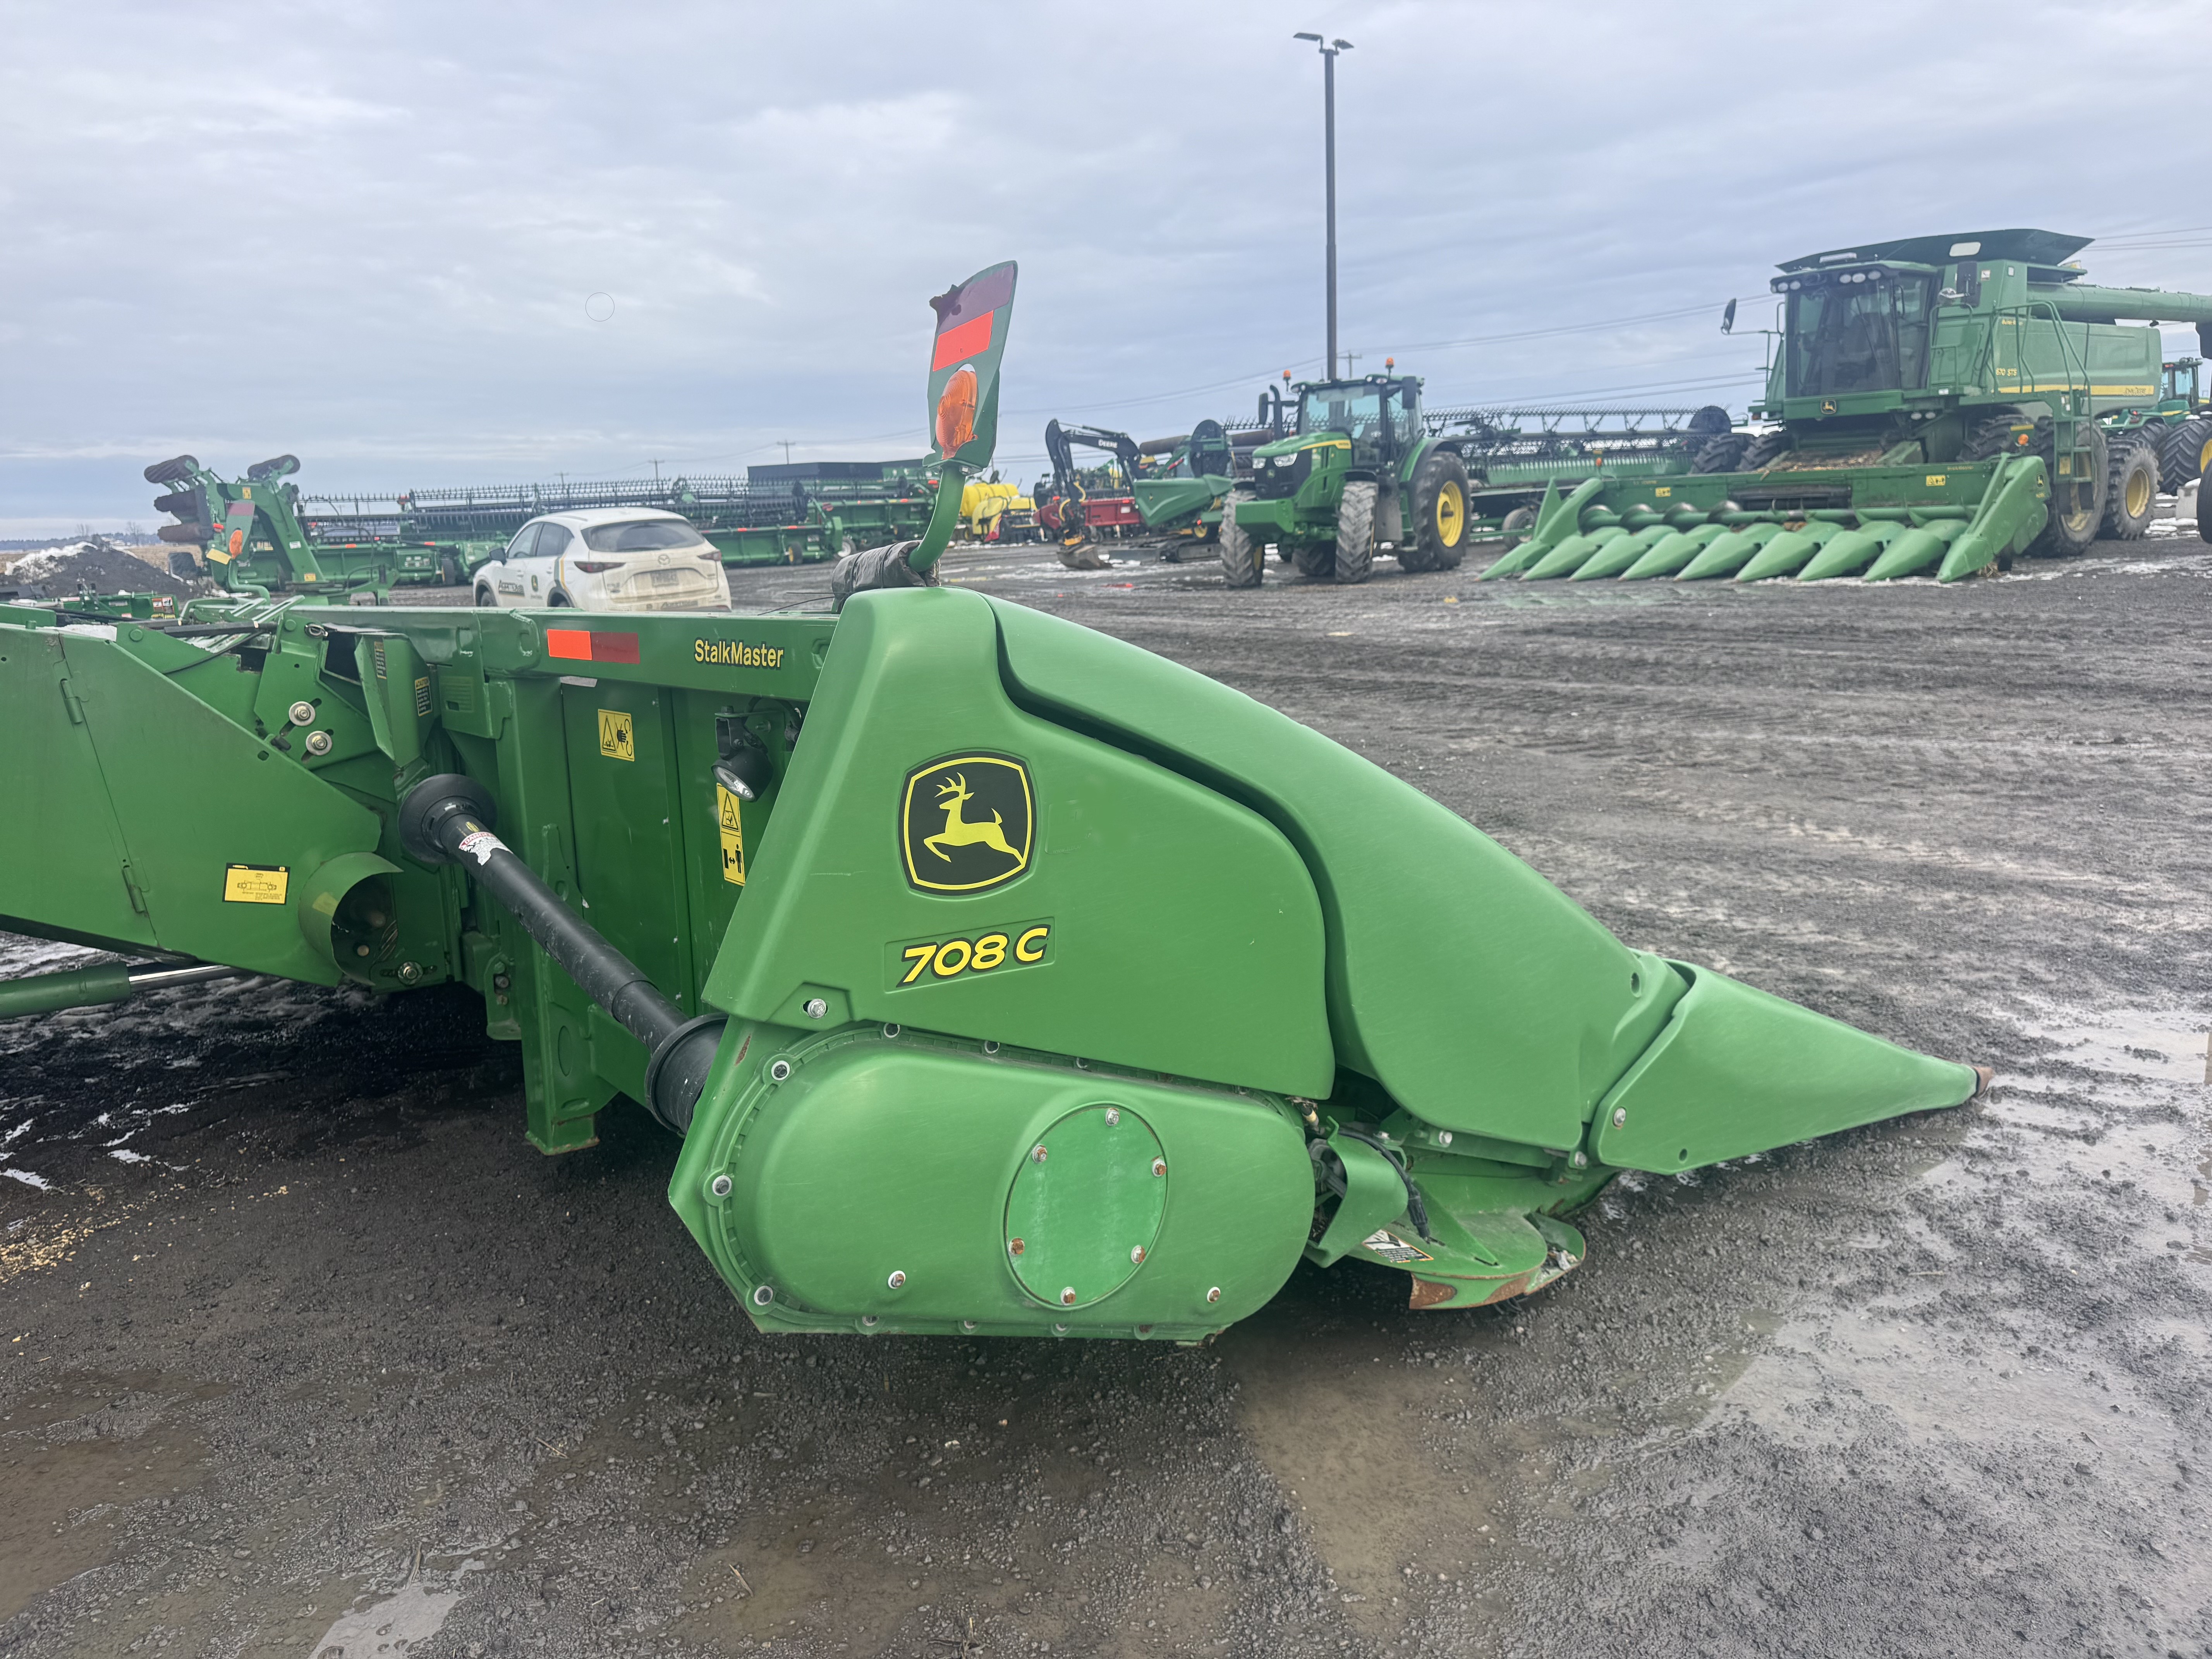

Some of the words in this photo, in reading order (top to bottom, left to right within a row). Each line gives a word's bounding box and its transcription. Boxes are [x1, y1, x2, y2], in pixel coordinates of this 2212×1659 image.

[1098, 439, 1118, 448] DEERE
[694, 639, 784, 669] StalkMaster
[899, 933, 1009, 985] 708
[1014, 926, 1049, 963] C
